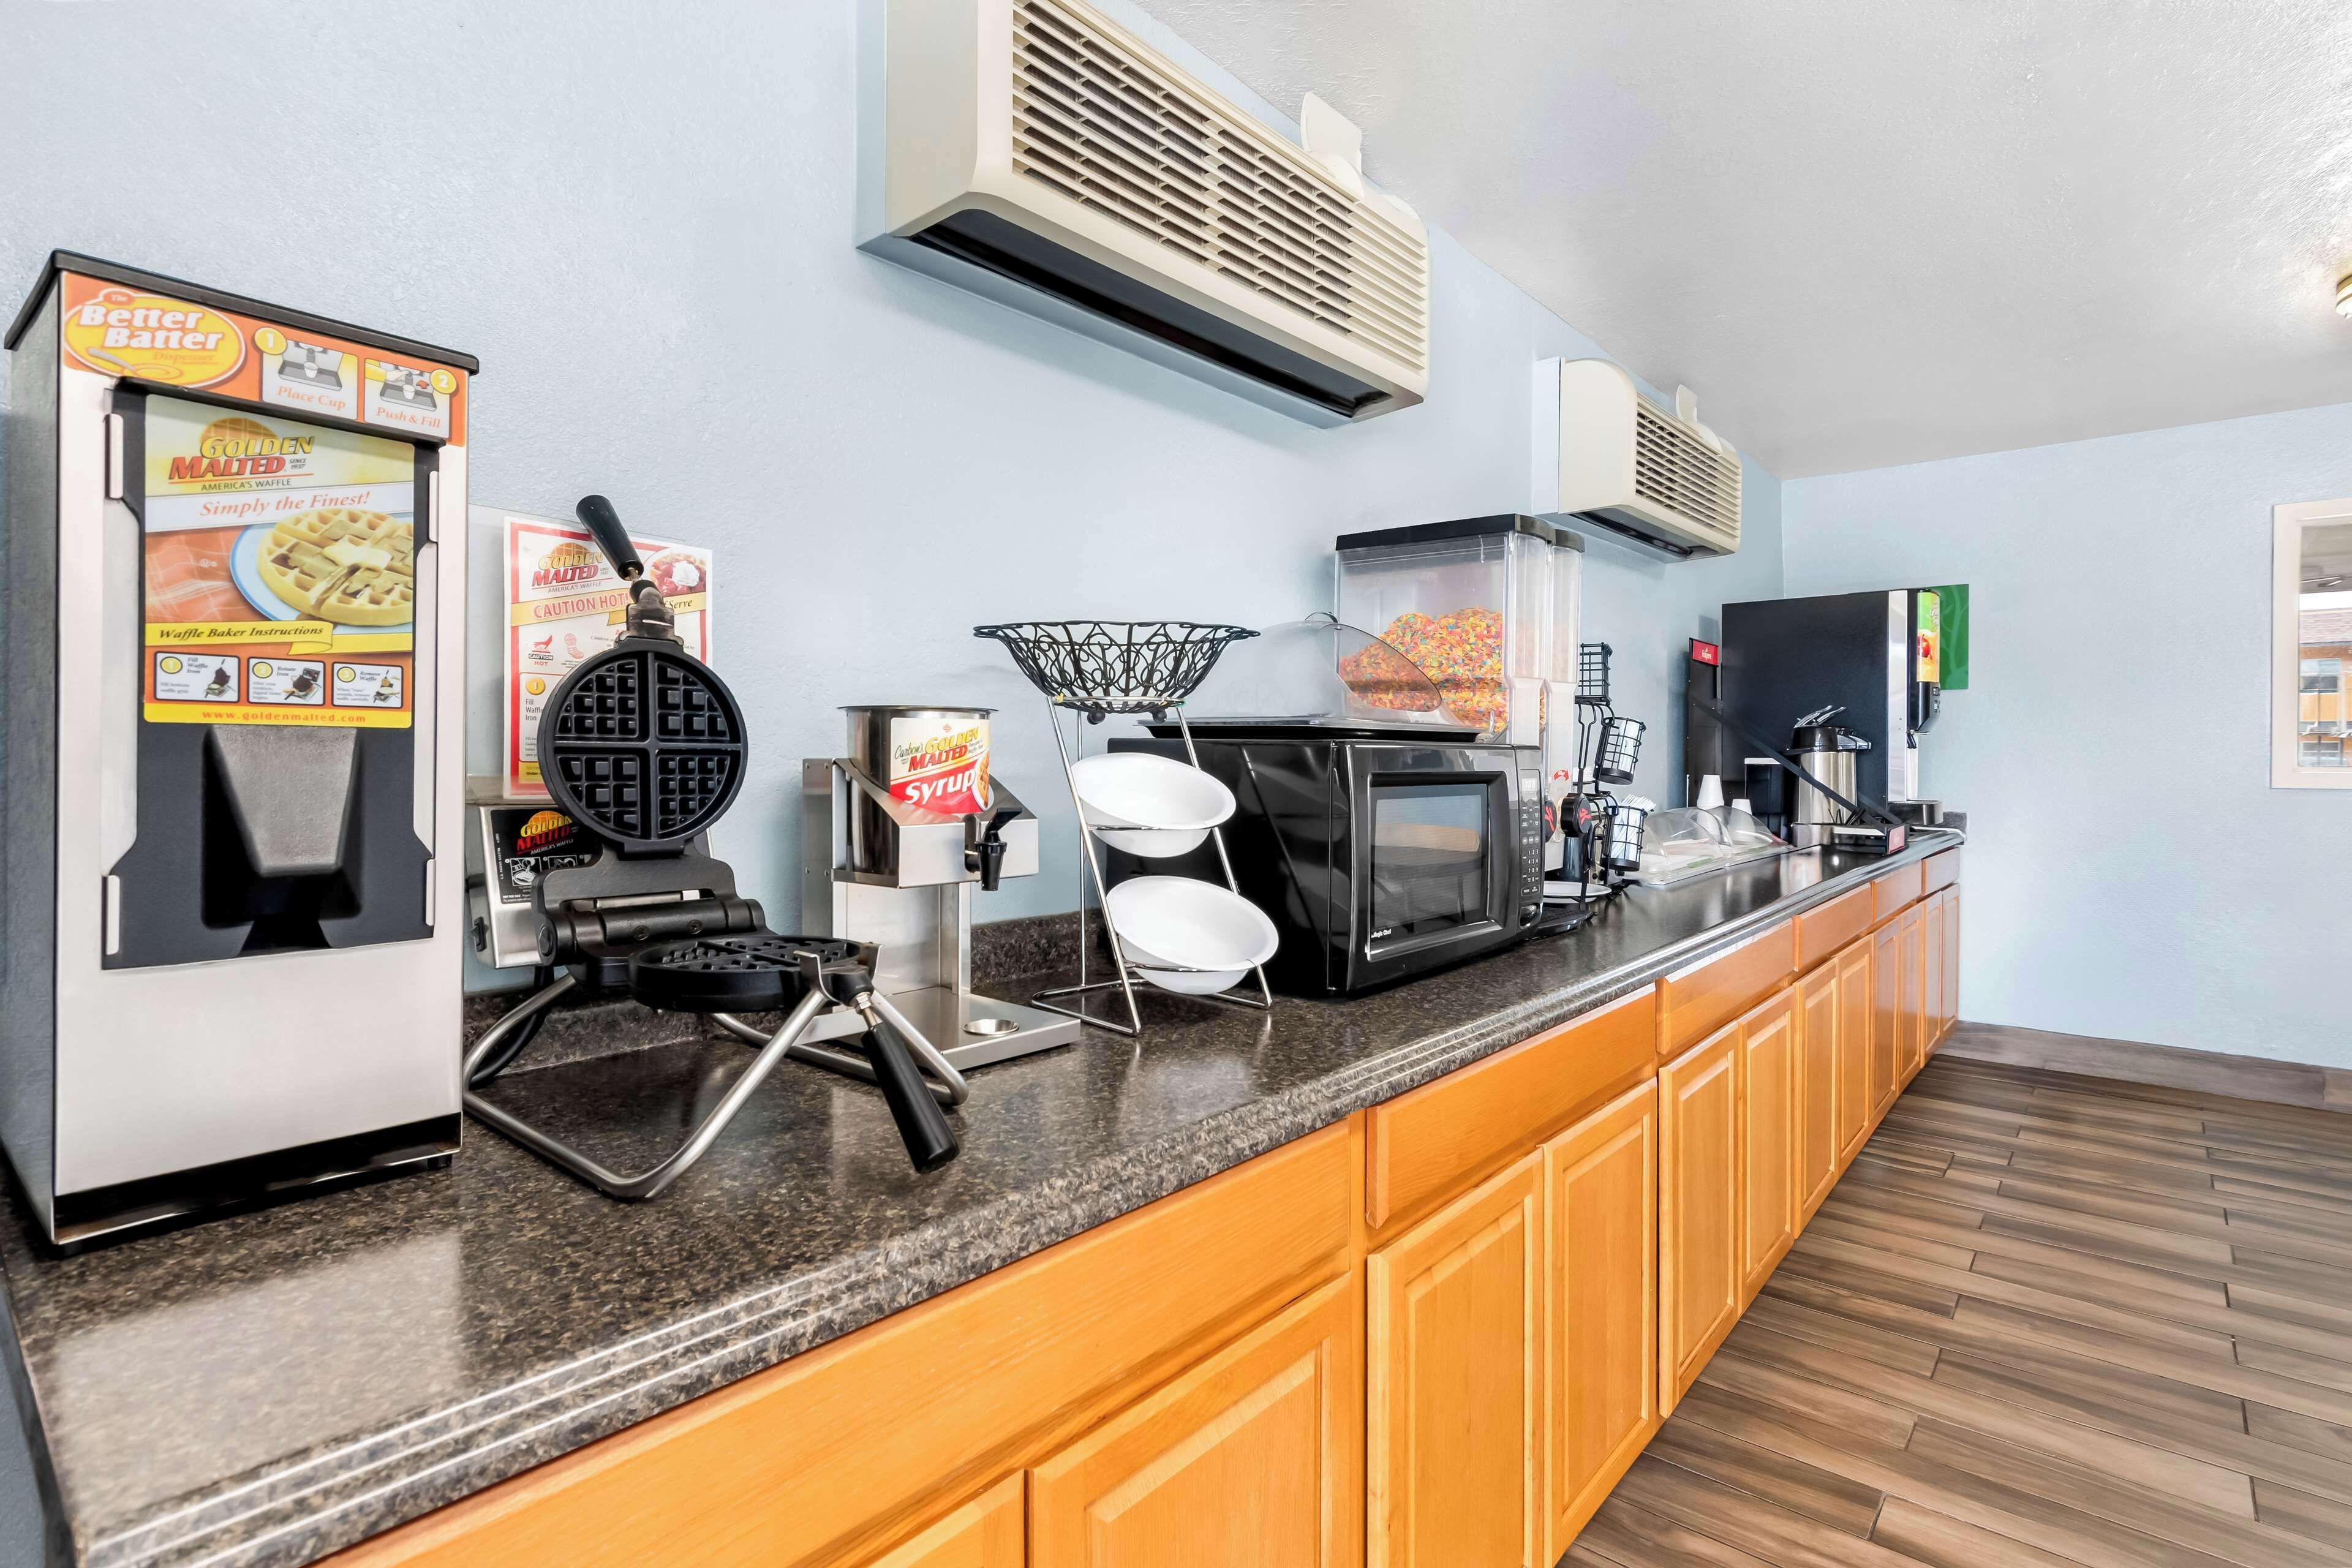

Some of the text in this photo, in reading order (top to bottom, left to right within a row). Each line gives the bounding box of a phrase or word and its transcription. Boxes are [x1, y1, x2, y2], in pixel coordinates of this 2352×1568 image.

[79, 304, 203, 328] Better
[103, 326, 223, 350] Batter
[267, 333, 274, 348] 1
[153, 352, 217, 364] Dispenser
[438, 375, 448, 388] 2
[276, 385, 346, 412] Place Cup
[376, 406, 407, 421] Push
[420, 417, 441, 429] Fill
[199, 435, 315, 459] GOLDEN
[168, 455, 287, 480] MALTED
[201, 478, 292, 491] AMERICA'S WAFFLE
[199, 491, 371, 519] Simply the Finest!
[538, 552, 603, 570] GOLDEN
[532, 564, 599, 587] MALTED
[548, 581, 602, 594] AMERICA'S WAFFLE
[533, 592, 629, 620] CAUTION HOT!
[159, 625, 323, 641] Waffle Baker Instructions
[202, 710, 366, 722] www.goldenmalted.com
[894, 742, 923, 760] Carbon's
[925, 726, 979, 755] GOLDEN
[908, 744, 968, 772] MALTED
[904, 769, 976, 805] Syrup
[530, 839, 574, 855] AMERICA'S WAFFLE
